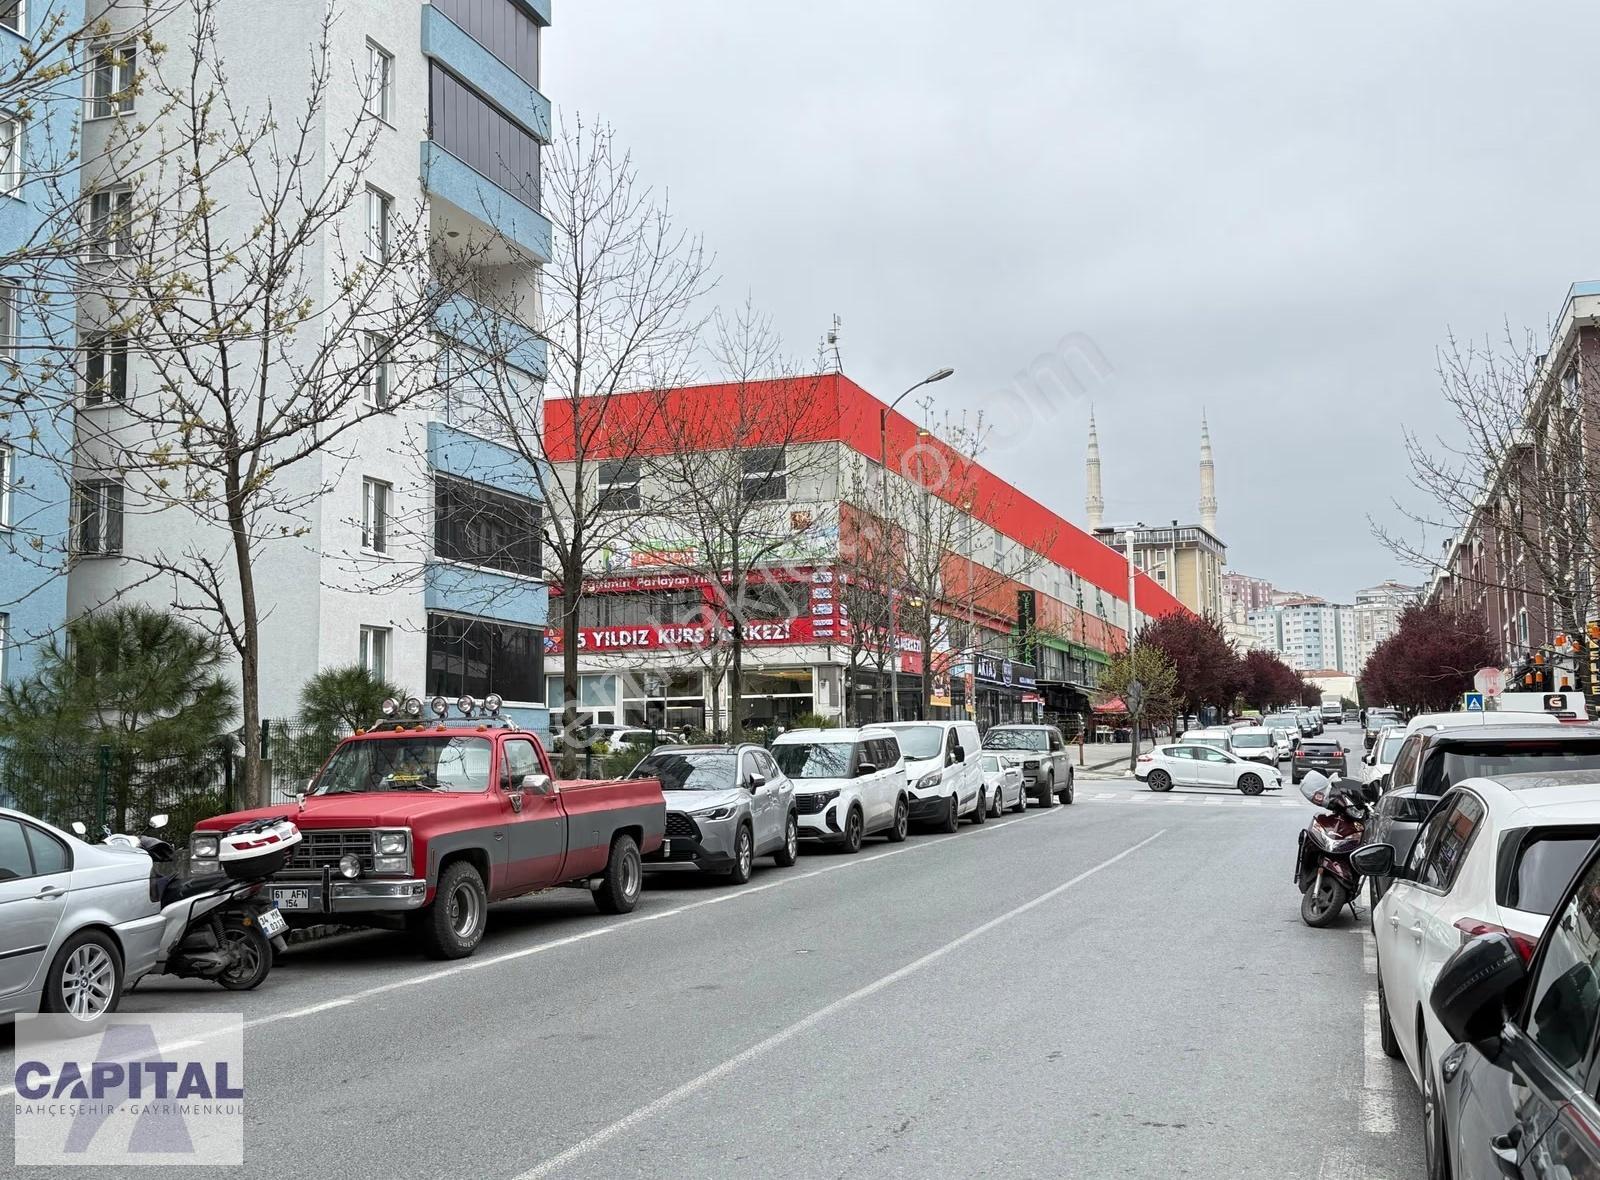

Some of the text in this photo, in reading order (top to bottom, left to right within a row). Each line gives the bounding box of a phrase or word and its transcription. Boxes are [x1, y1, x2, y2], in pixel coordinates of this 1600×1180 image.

[592, 629, 650, 647] YILDIZ
[658, 626, 705, 644] KURS
[711, 618, 790, 643] RKEZİ
[275, 890, 307, 899] 61 AFN
[285, 899, 298, 908] 154
[260, 916, 269, 925] 34
